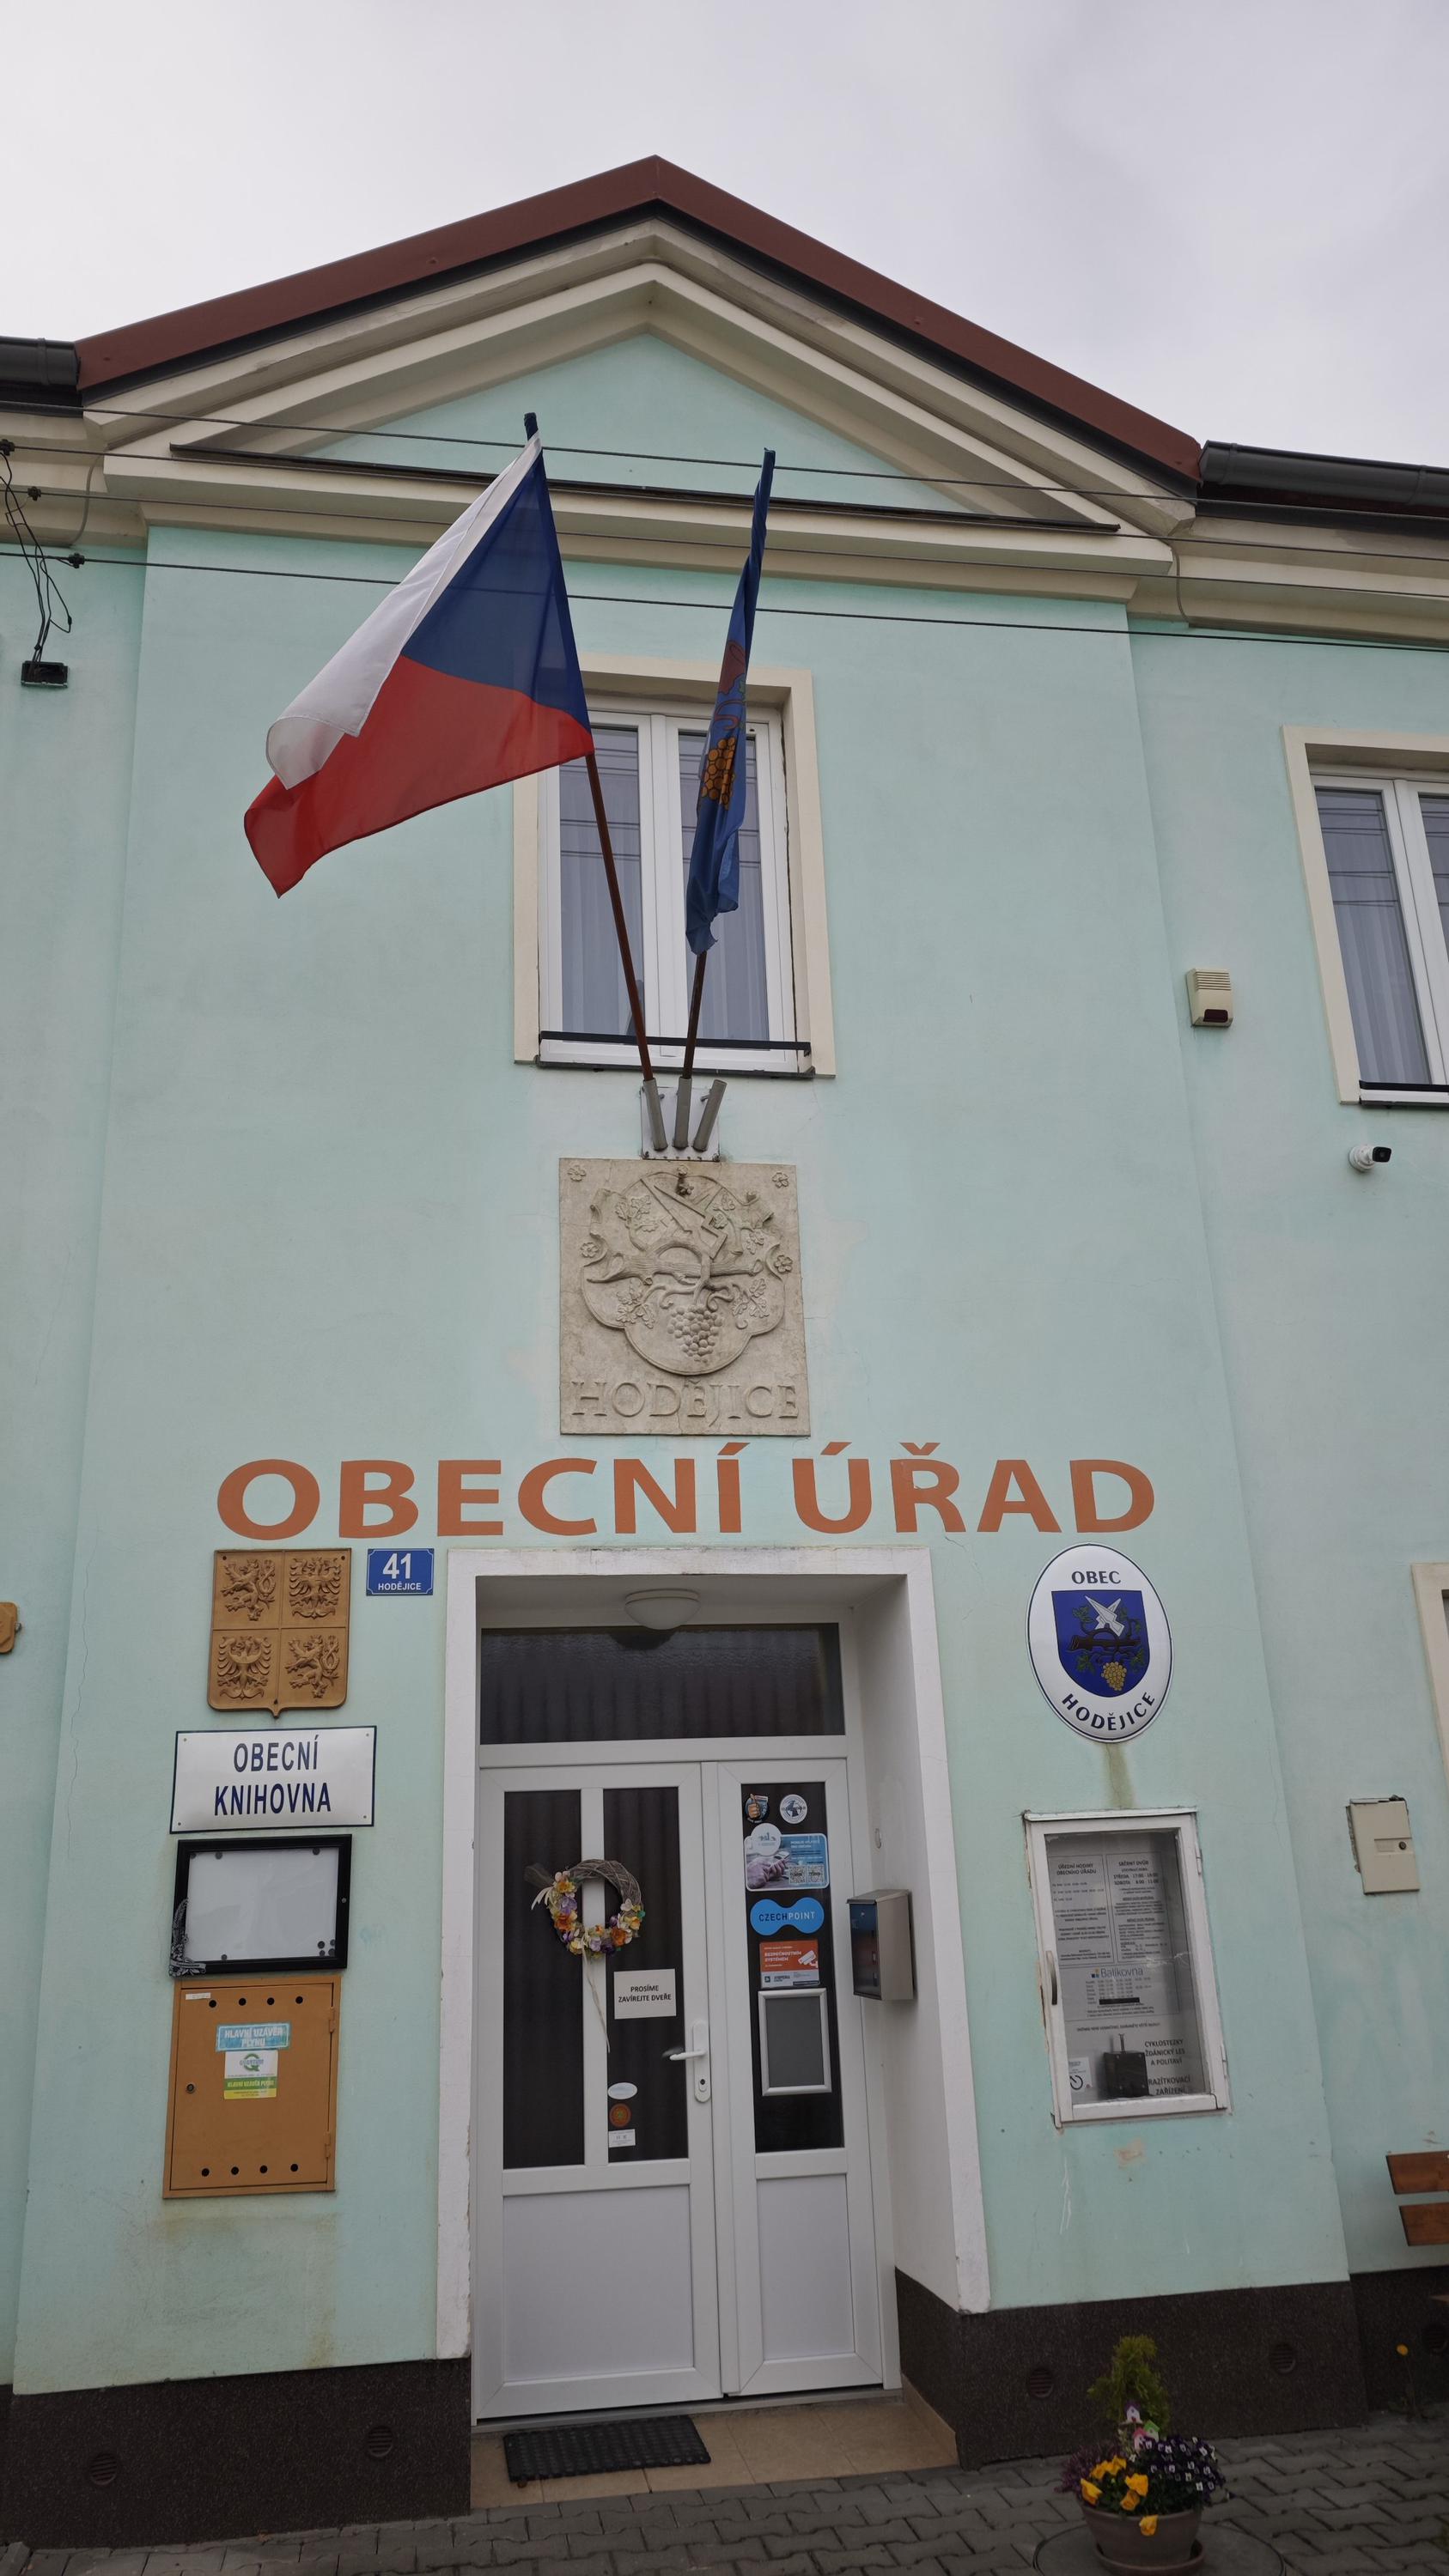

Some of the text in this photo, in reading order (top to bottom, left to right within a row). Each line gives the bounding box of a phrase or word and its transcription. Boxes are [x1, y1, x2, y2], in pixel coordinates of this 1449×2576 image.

[571, 1380, 799, 1427] HODĚJICE
[217, 1442, 1155, 1540] OBECNÍ ÚŘAD
[383, 1552, 411, 1579] 41
[1071, 1571, 1122, 1584] OBEC
[378, 1581, 422, 1590] HODĚJICE
[1062, 1692, 1155, 1731] HODĚJICE
[234, 1735, 319, 1773] OBECNÍ
[214, 1783, 332, 1816] KNIHOVNA
[618, 1993, 672, 2003] ZAVÍREJTE DVEŘE
